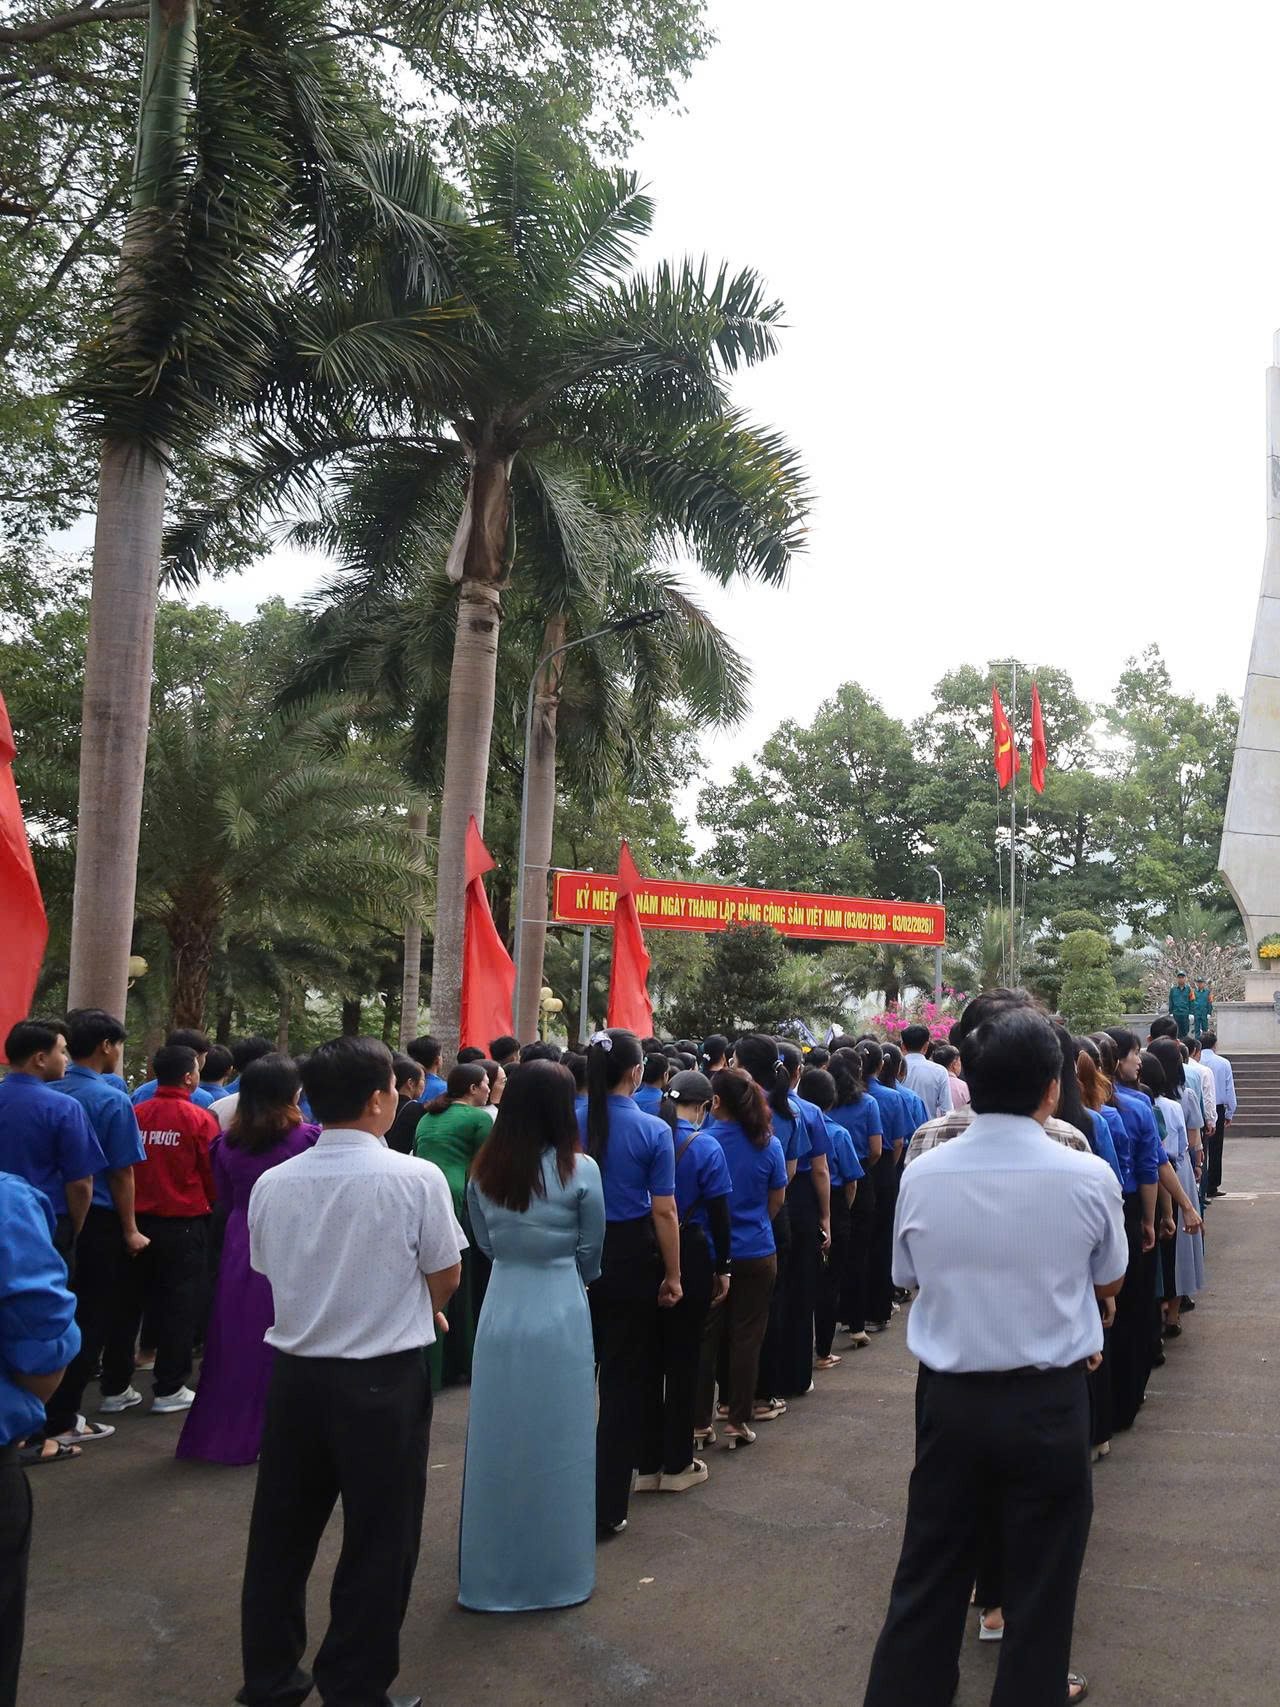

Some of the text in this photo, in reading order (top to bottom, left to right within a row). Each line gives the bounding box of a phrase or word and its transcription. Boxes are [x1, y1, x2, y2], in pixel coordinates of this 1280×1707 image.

[576, 882, 590, 909] KỶ
[592, 887, 617, 915] NIỆM
[636, 891, 659, 914] NĂM
[660, 893, 686, 917] NGÀY
[688, 896, 718, 920] THÀNH
[719, 897, 736, 924] LẬP
[738, 897, 761, 922] ĐẢNG
[763, 902, 786, 927] CỘNG
[788, 901, 804, 925] SẢN
[806, 905, 823, 930] VIỆT
[824, 911, 842, 928] NAM
[844, 911, 887, 931] (03/02/1930
